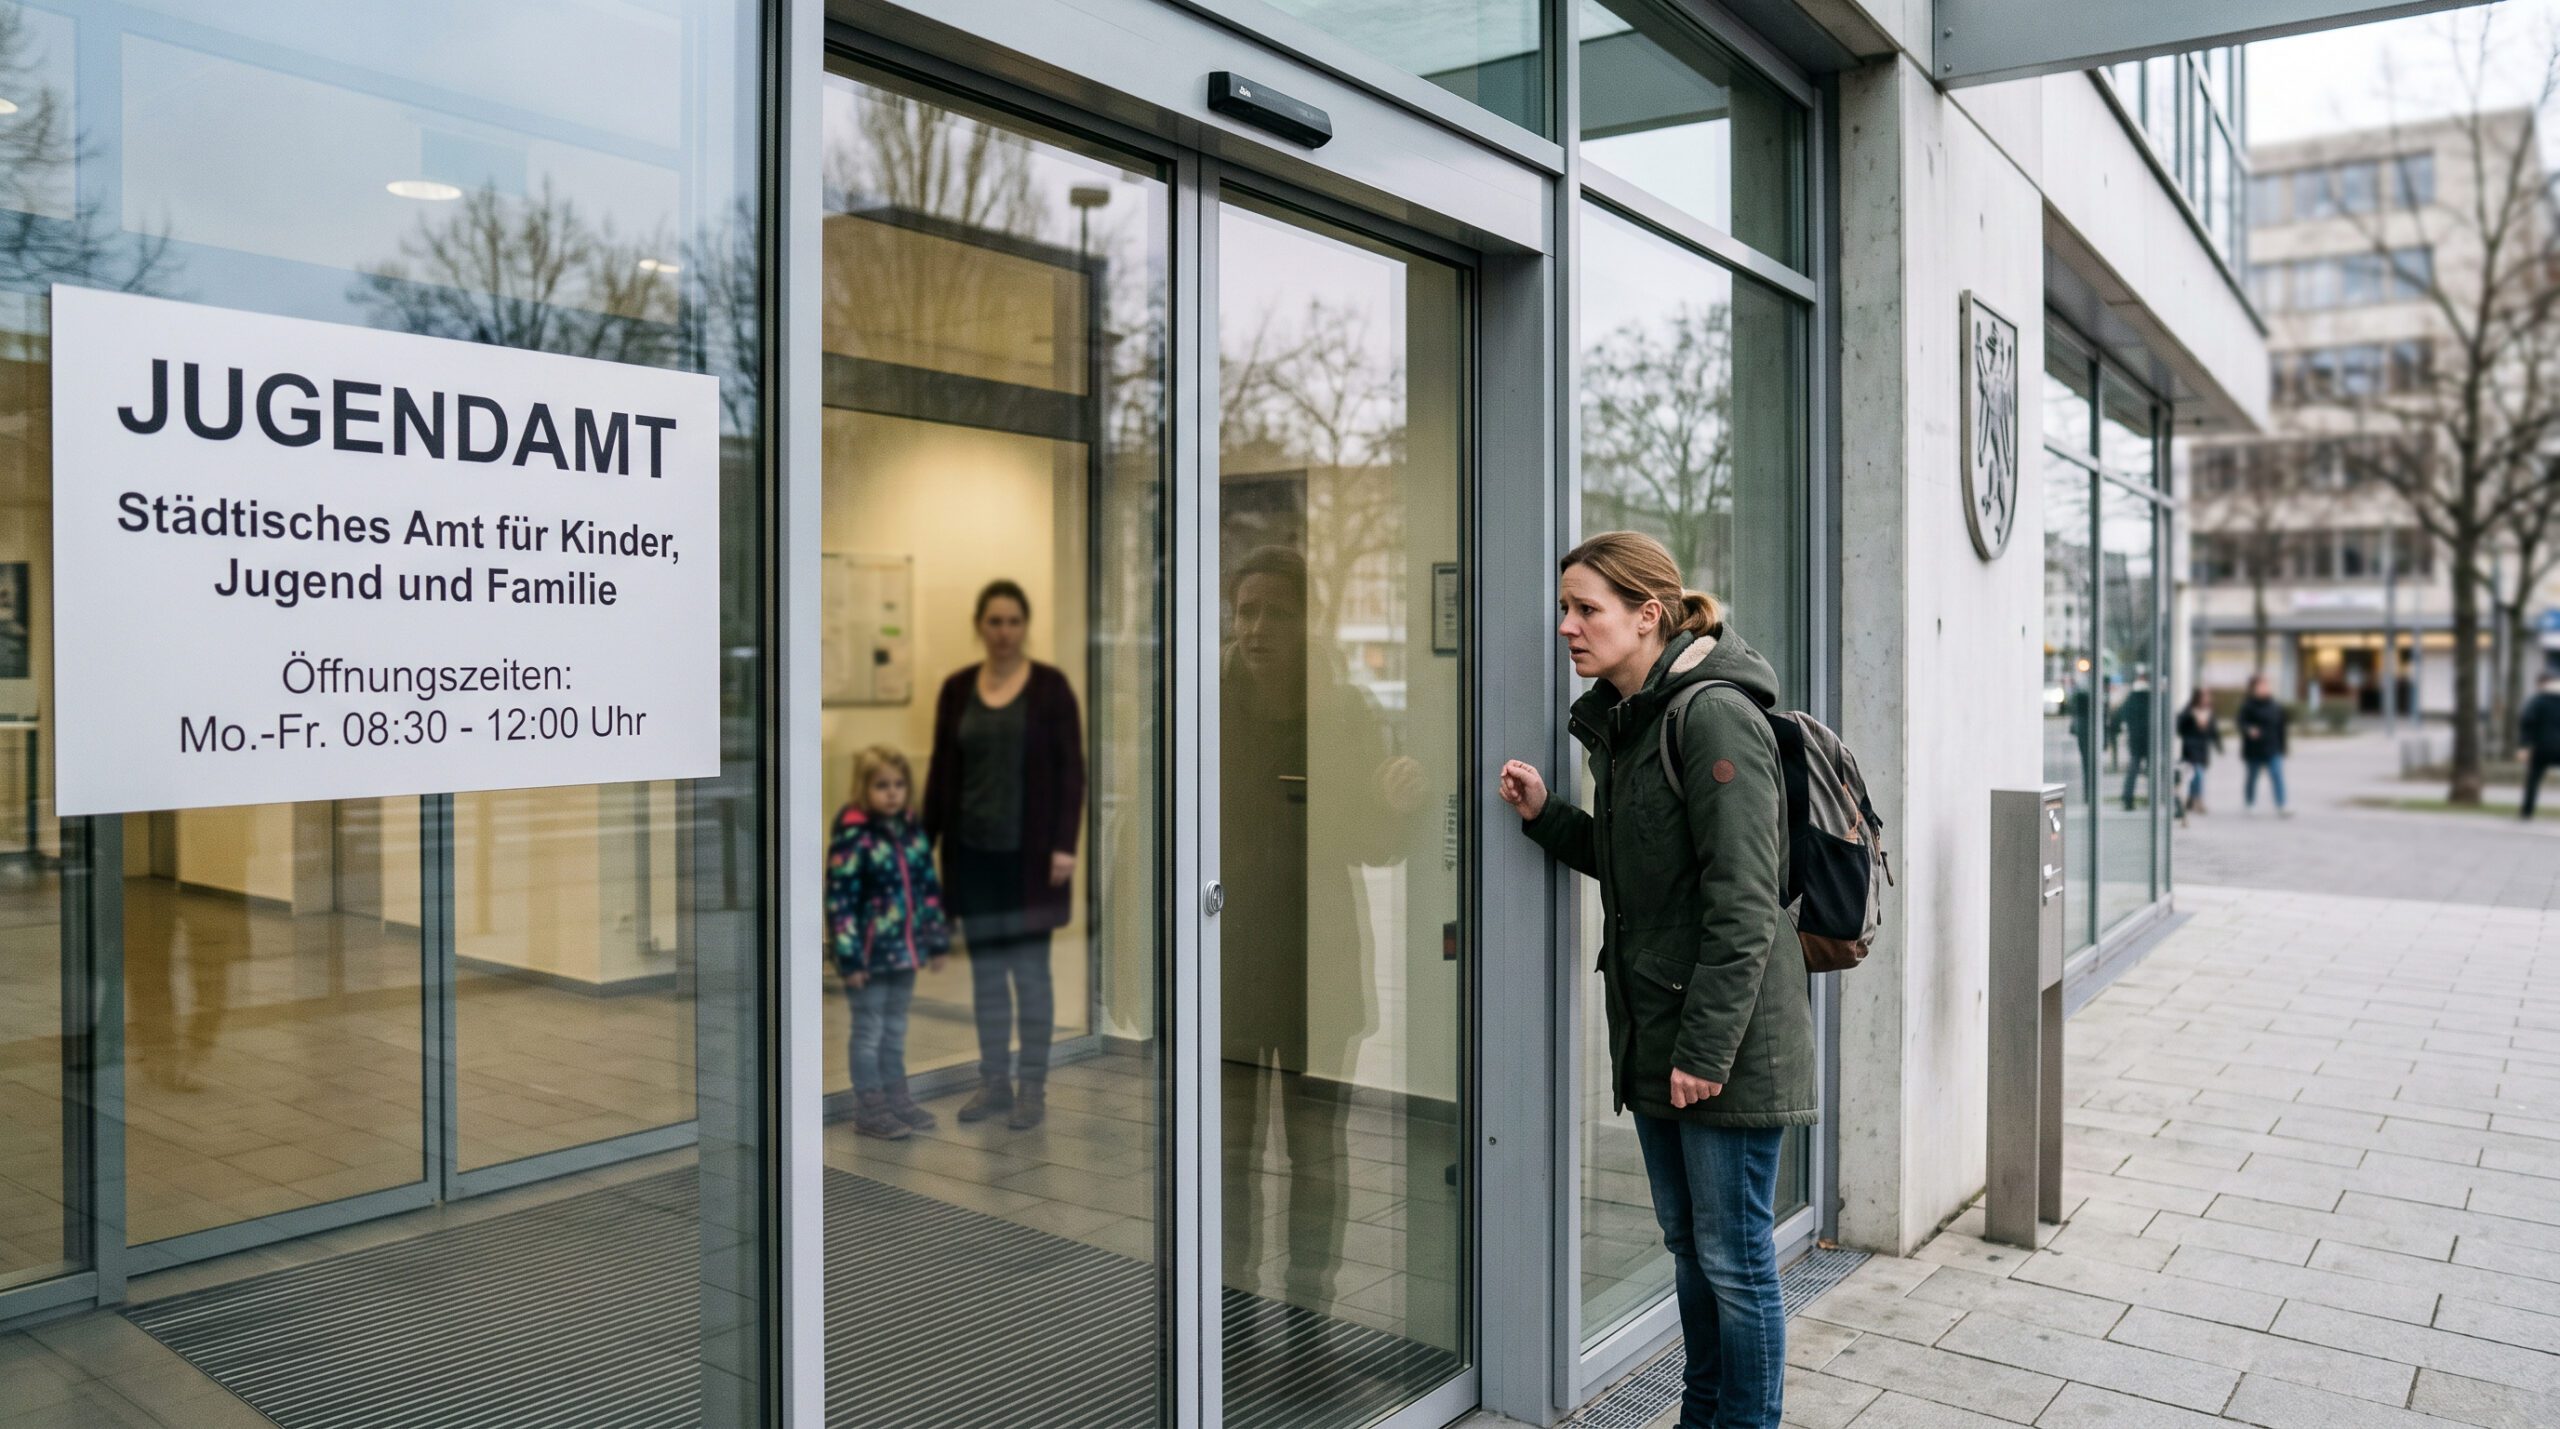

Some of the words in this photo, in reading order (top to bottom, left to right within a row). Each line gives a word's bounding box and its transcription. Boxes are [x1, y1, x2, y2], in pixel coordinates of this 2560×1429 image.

[117, 358, 677, 479] JUGENDAMT
[117, 491, 391, 545] Städtisches
[403, 509, 485, 549] Amt
[495, 514, 549, 552] für
[561, 518, 679, 565] Kinder,
[214, 557, 382, 609] Jugend
[399, 566, 473, 603] und
[488, 567, 617, 606] Familie
[282, 650, 571, 702] Öffnungszeiten:
[180, 713, 326, 754] Mo.-Fr.
[342, 709, 447, 748] 08:30
[487, 706, 579, 742] 12:00
[591, 704, 647, 738] Uhr
